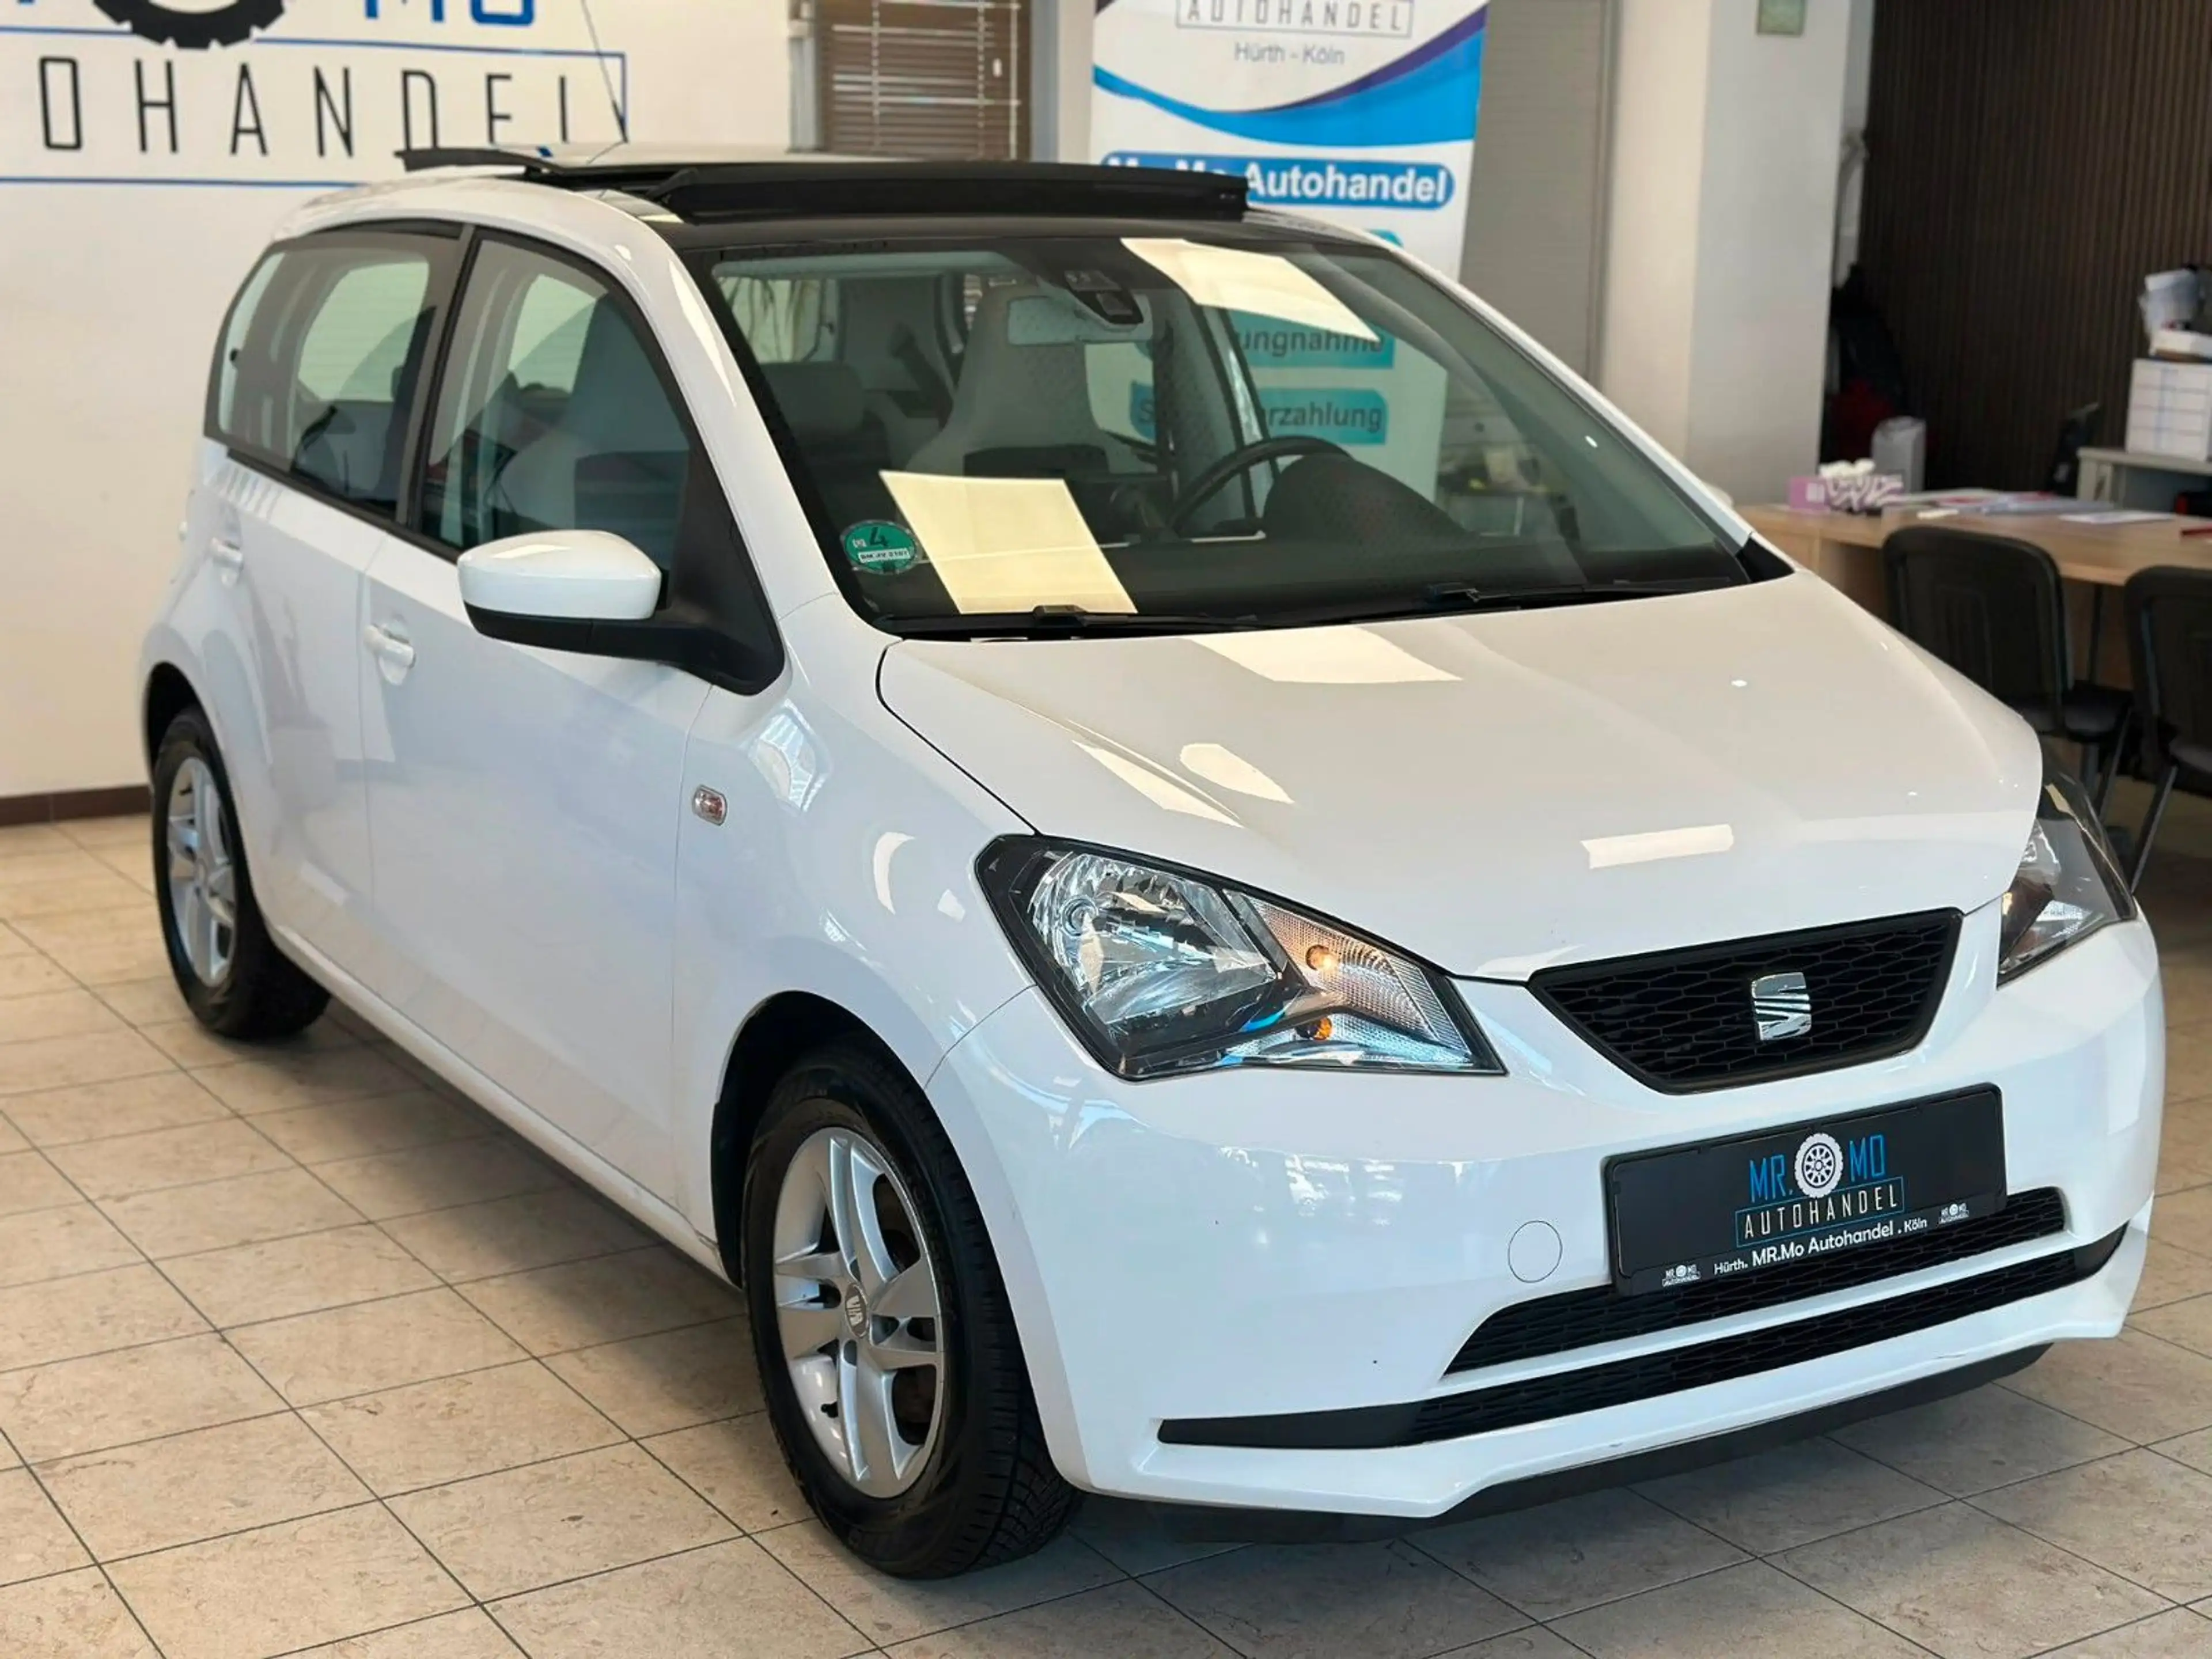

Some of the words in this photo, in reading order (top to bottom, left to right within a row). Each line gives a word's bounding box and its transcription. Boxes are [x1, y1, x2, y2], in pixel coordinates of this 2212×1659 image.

[1234, 41, 1286, 63] Hürth
[1302, 45, 1346, 65] Köln
[1245, 161, 1448, 203] Autohandel
[1238, 330, 1384, 357] ungnahme
[1268, 401, 1382, 433] rzahlung
[869, 527, 888, 546] 4
[1749, 1154, 1794, 1203] MR.
[1849, 1134, 1887, 1181] MO
[1744, 1184, 1899, 1240] AUTOHANDEL
[1752, 1241, 1805, 1268] MR.Mo
[1808, 1220, 1894, 1254] Autohandel
[1904, 1217, 1928, 1233] Köln
